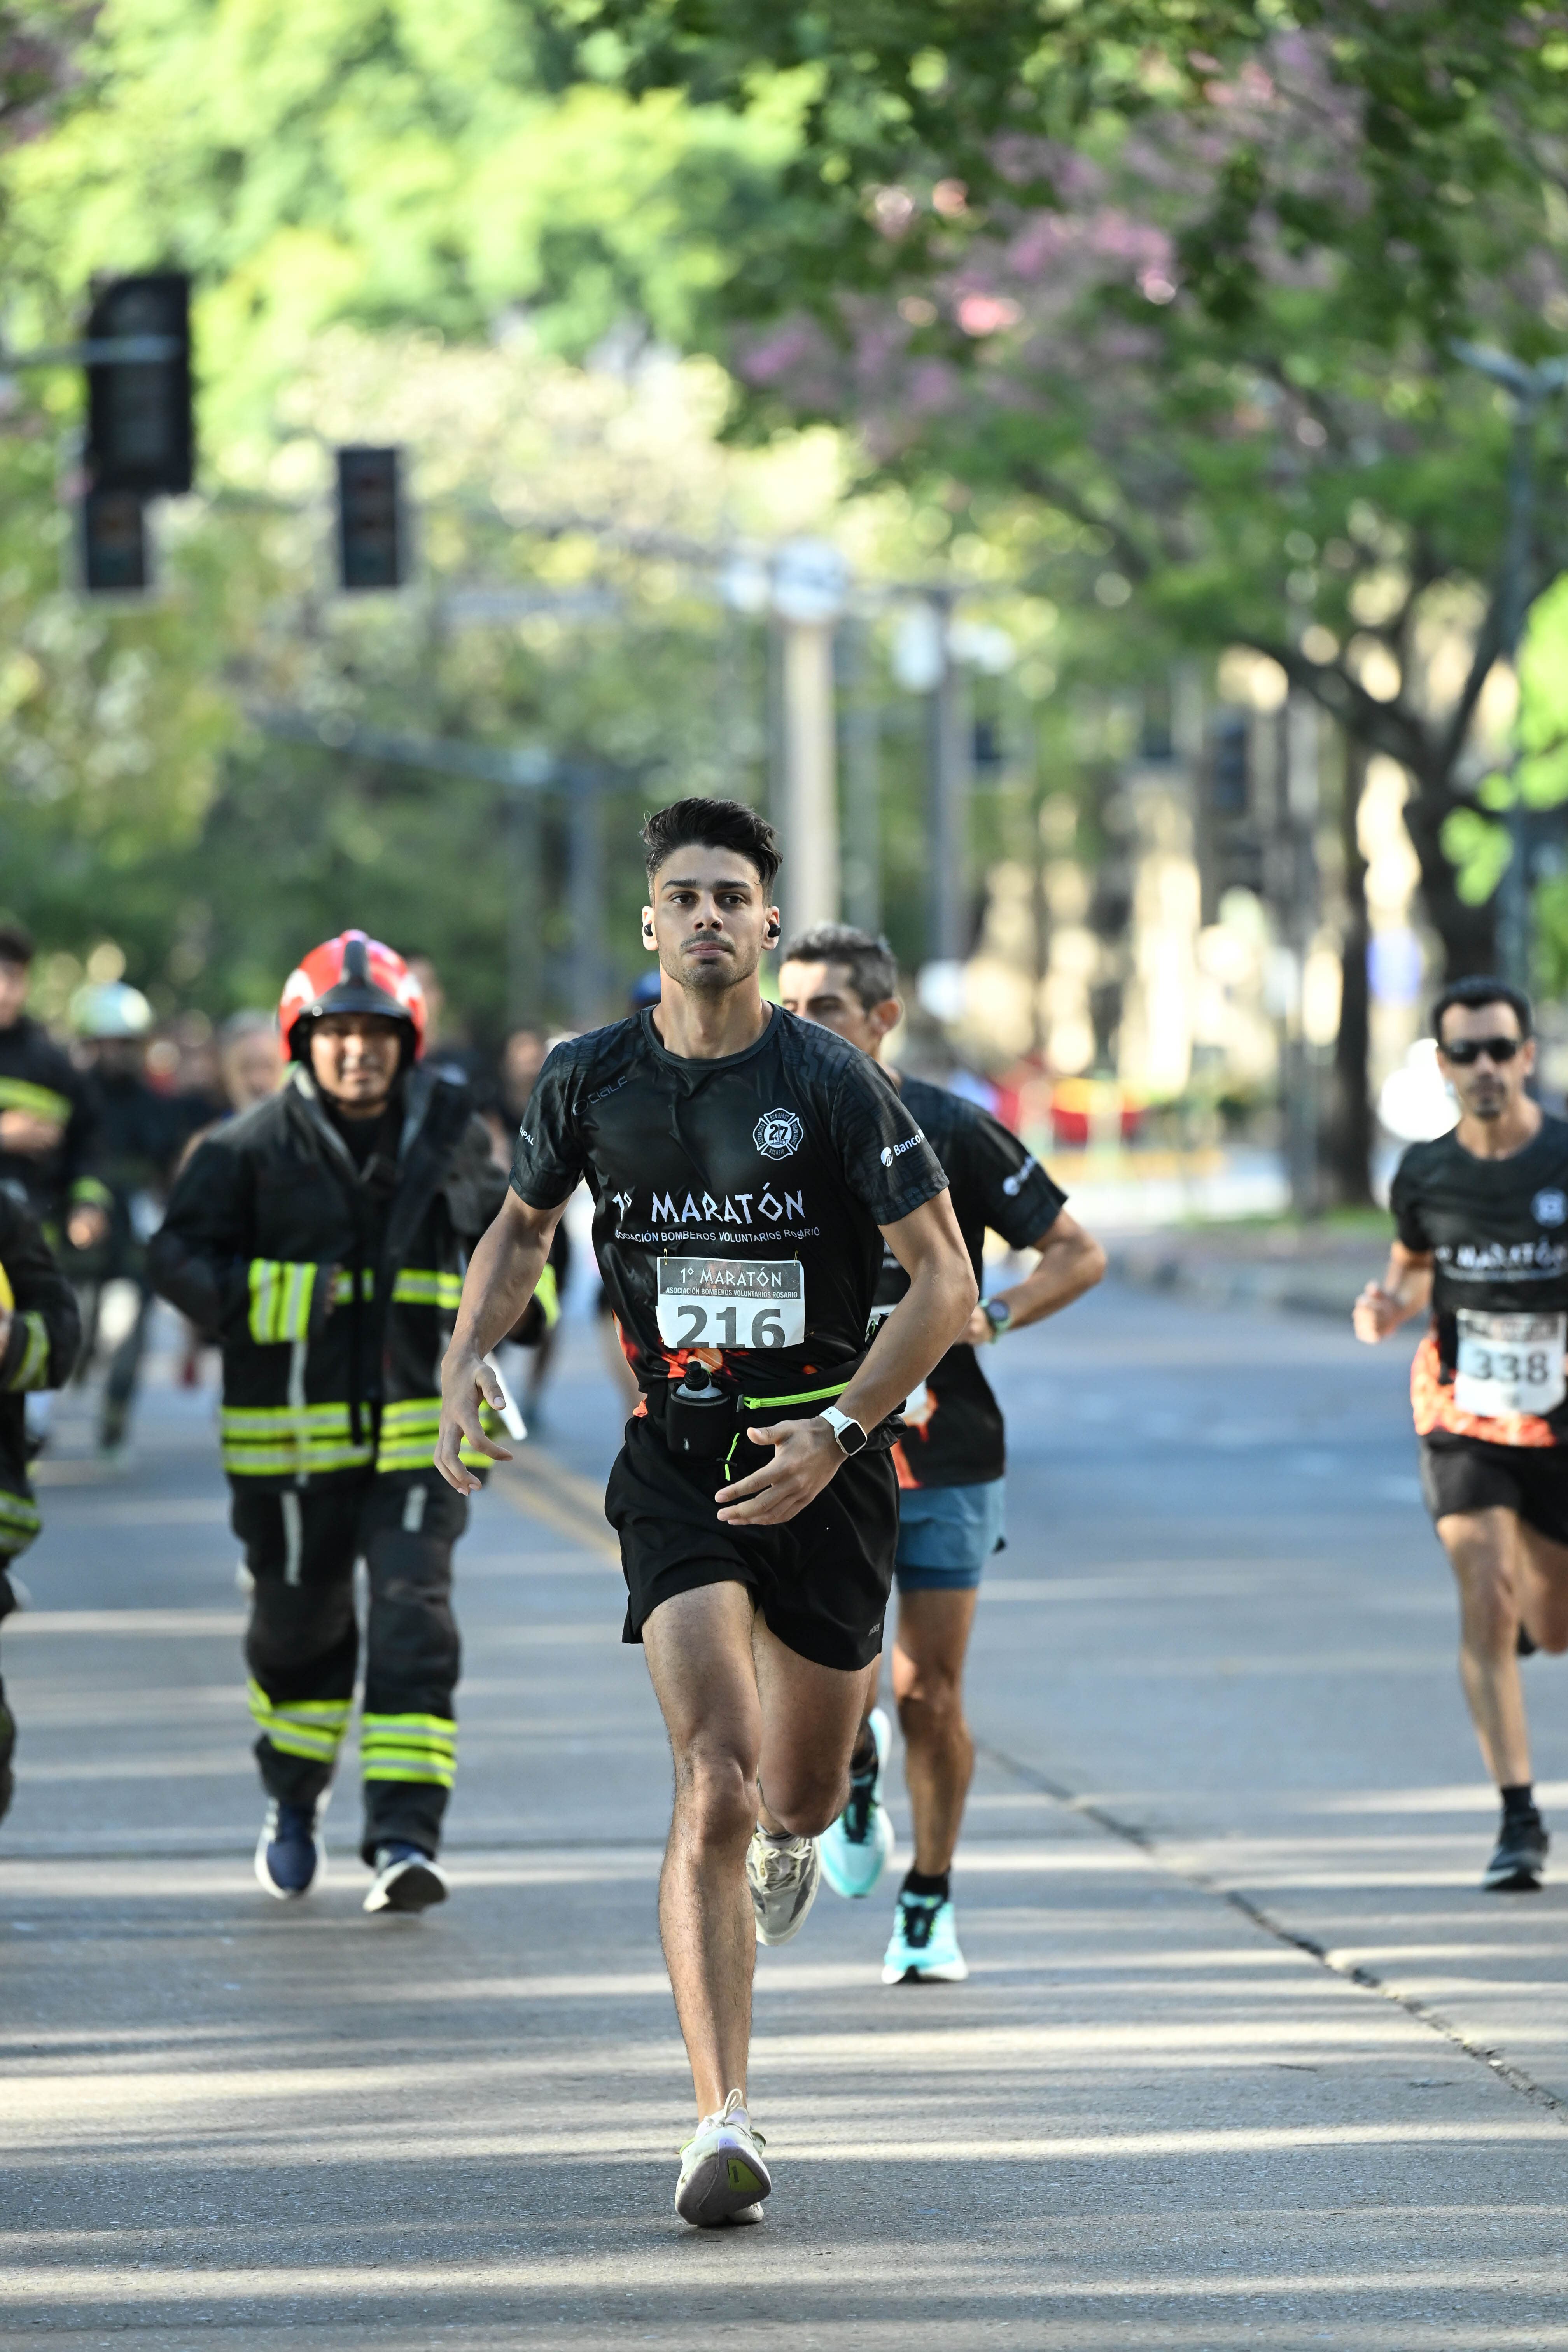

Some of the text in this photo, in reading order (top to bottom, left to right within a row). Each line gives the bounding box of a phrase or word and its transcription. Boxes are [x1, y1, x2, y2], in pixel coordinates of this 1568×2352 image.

[769, 1124, 788, 1141] 27
[893, 1134, 921, 1156] Banco
[651, 1182, 805, 1224] MARATÓN
[661, 1231, 716, 1241] BOMBEROS
[719, 1230, 782, 1242] VOLUNTARIOS
[700, 1267, 782, 1288] MARATÓN
[666, 1286, 700, 1295] ASOCIACIÓN
[733, 1290, 771, 1298] VOLUNTARIOS
[677, 1305, 786, 1348] 216
[1472, 1349, 1549, 1384] 338
